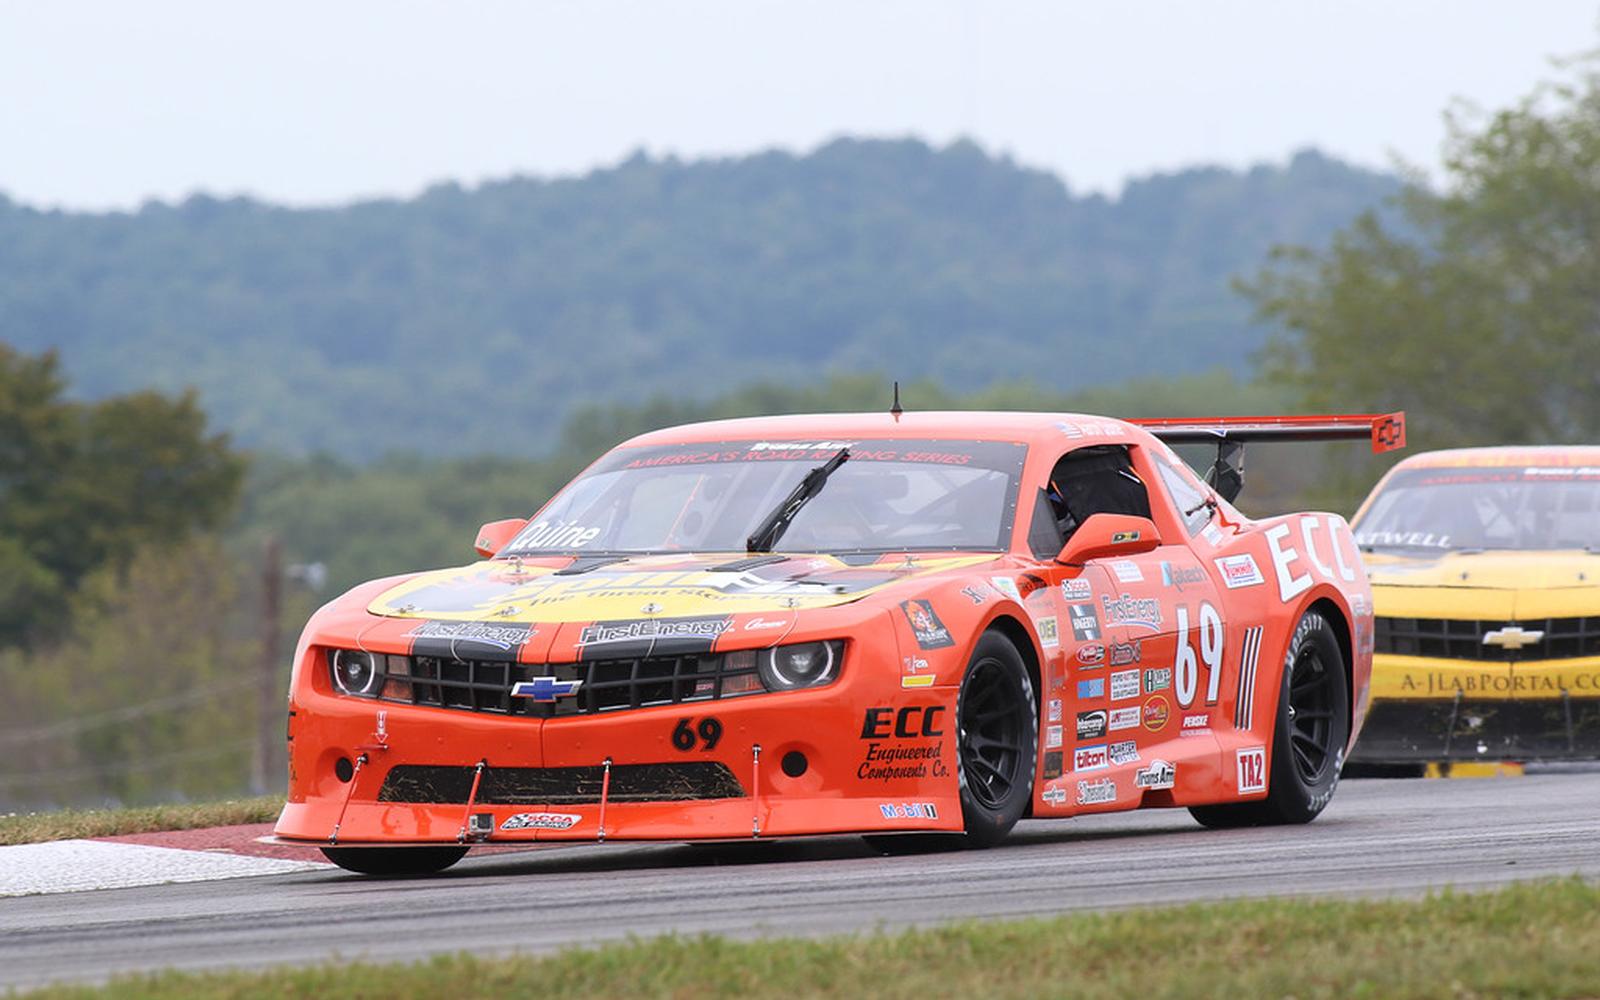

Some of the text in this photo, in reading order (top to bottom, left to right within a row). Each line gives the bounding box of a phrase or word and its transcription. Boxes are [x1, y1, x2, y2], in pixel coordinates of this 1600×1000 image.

[627, 451, 740, 469] AMERICA'S
[743, 450, 810, 462] ROAD
[900, 452, 972, 464] SERIES
[507, 520, 601, 551] Quine
[1264, 517, 1355, 603] ECC
[1102, 594, 1163, 624] FirstEnergy
[581, 618, 734, 643] FirstEnergy
[1175, 602, 1225, 709] 69
[672, 716, 723, 752] 69
[860, 705, 945, 739] ECC
[866, 742, 944, 764] Engineered
[857, 759, 950, 782] Components Co.
[1137, 769, 1160, 786] Trans
[1239, 752, 1264, 788] TA2
[880, 804, 921, 819] Mobil
